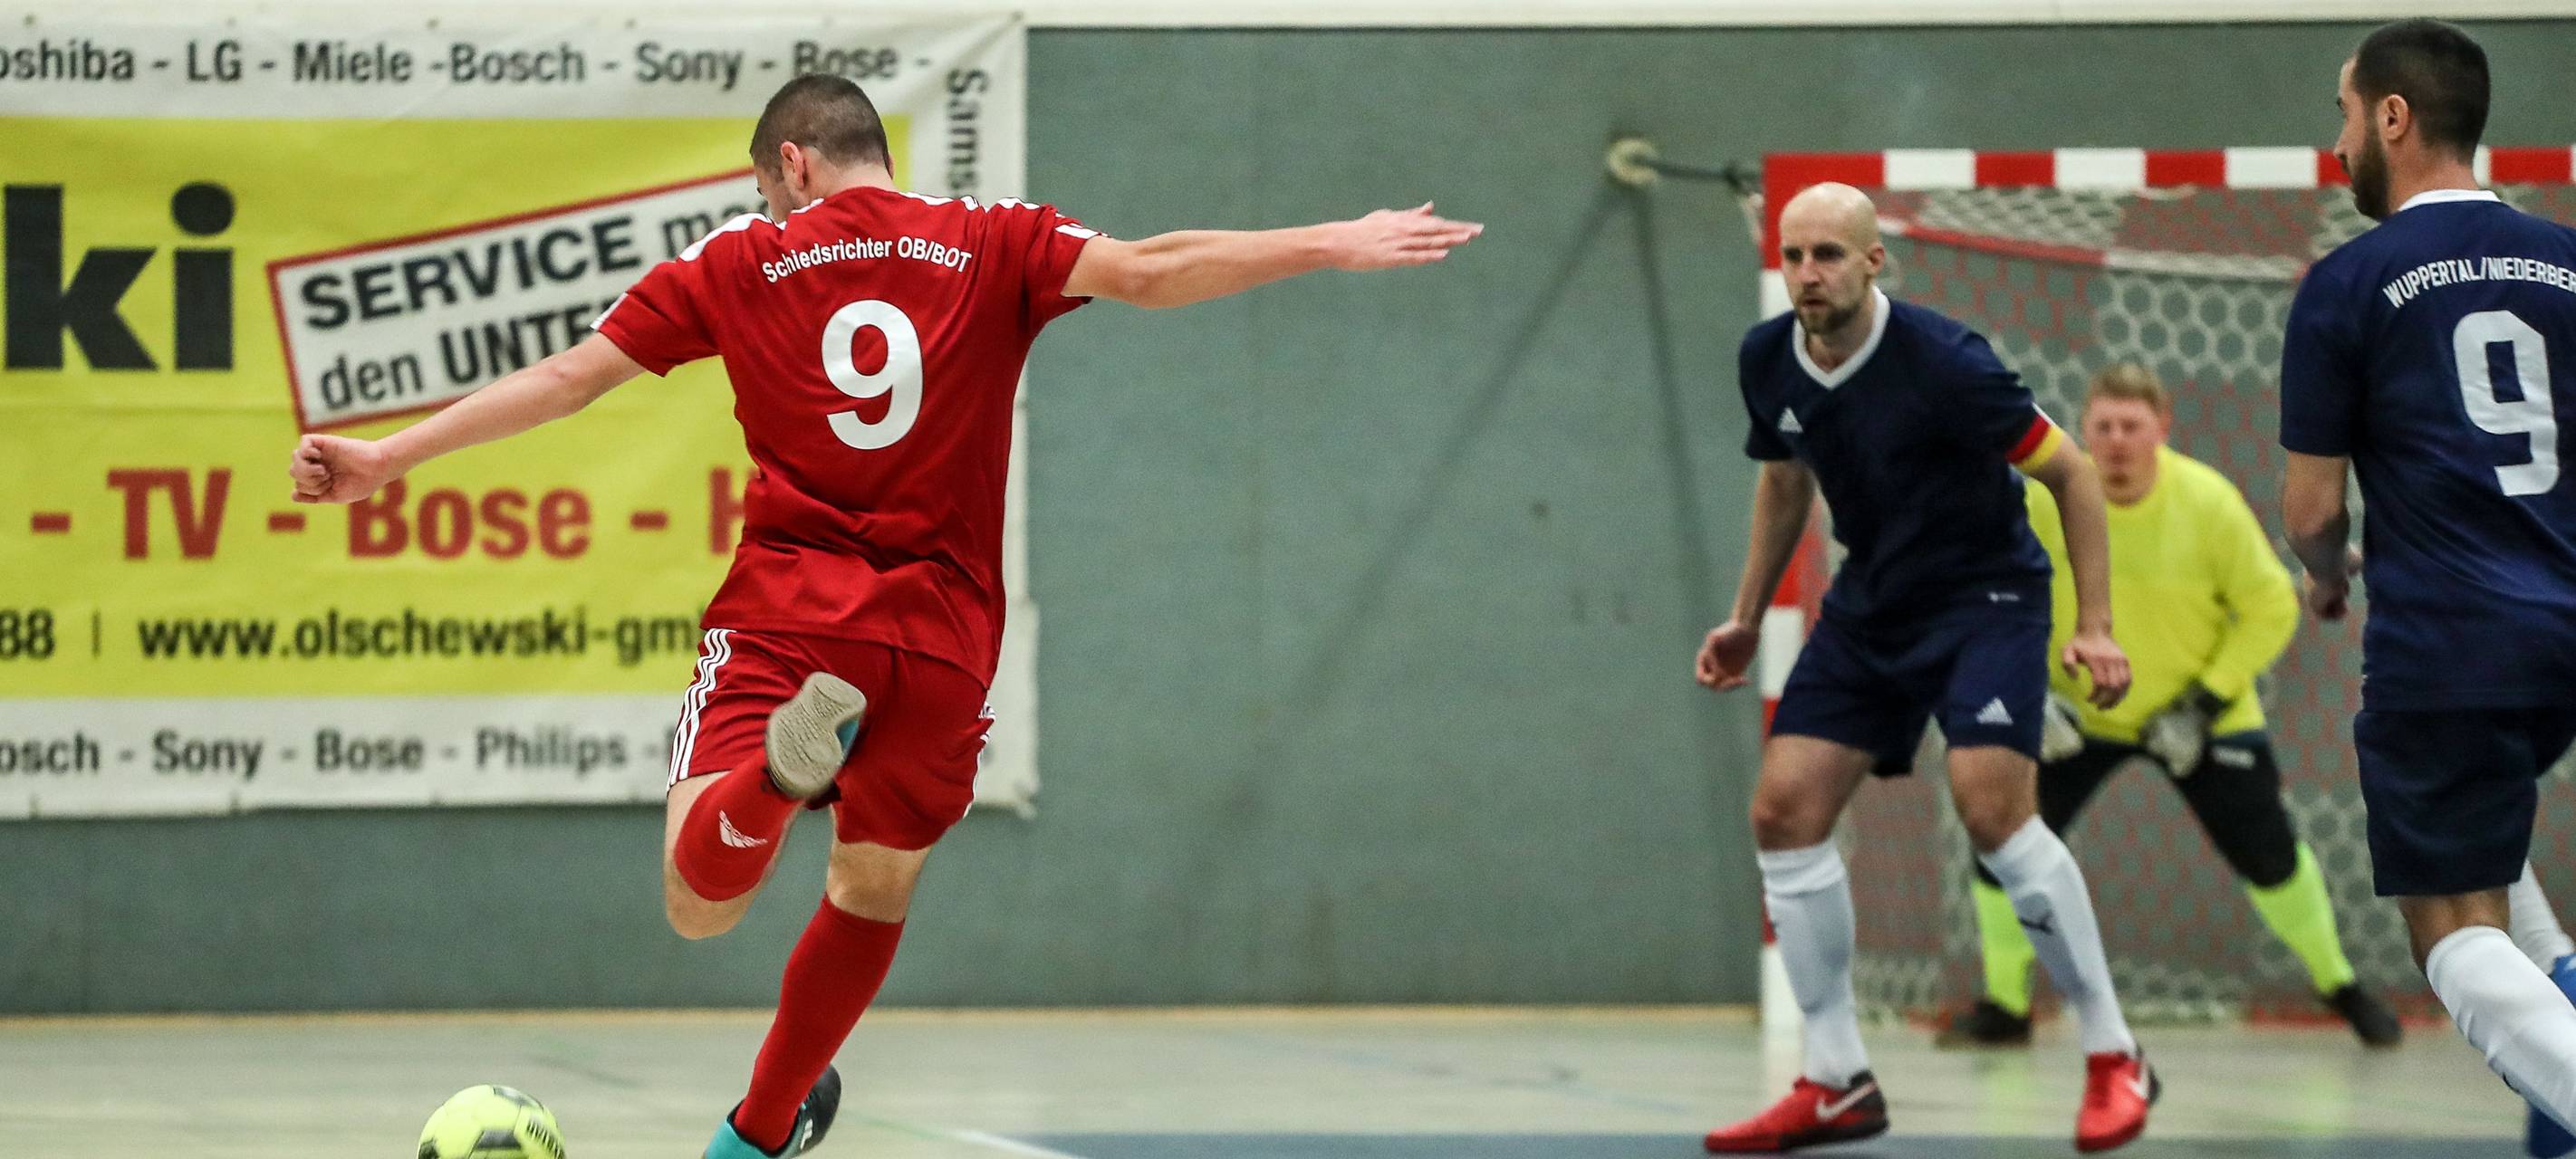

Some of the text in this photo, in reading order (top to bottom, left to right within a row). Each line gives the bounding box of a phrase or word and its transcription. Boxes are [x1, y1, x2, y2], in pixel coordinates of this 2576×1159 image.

[187, 42, 244, 82] LG
[293, 42, 413, 82] Miele
[635, 42, 744, 90] Sony
[793, 41, 899, 78] Bose
[947, 69, 989, 200] Sams
[3, 181, 236, 372] ki
[301, 216, 641, 330] SERVICE
[762, 236, 973, 283] Schiedsrichter OB/BOT
[320, 296, 621, 410] den UNTE
[822, 300, 924, 450] 9
[2453, 310, 2561, 497] 9
[107, 467, 233, 561] TV
[349, 477, 592, 560] Bose
[139, 608, 703, 666] www.olschewski-gm
[152, 728, 264, 781] Sony
[314, 729, 426, 772] Bose
[476, 727, 627, 774] Philips
